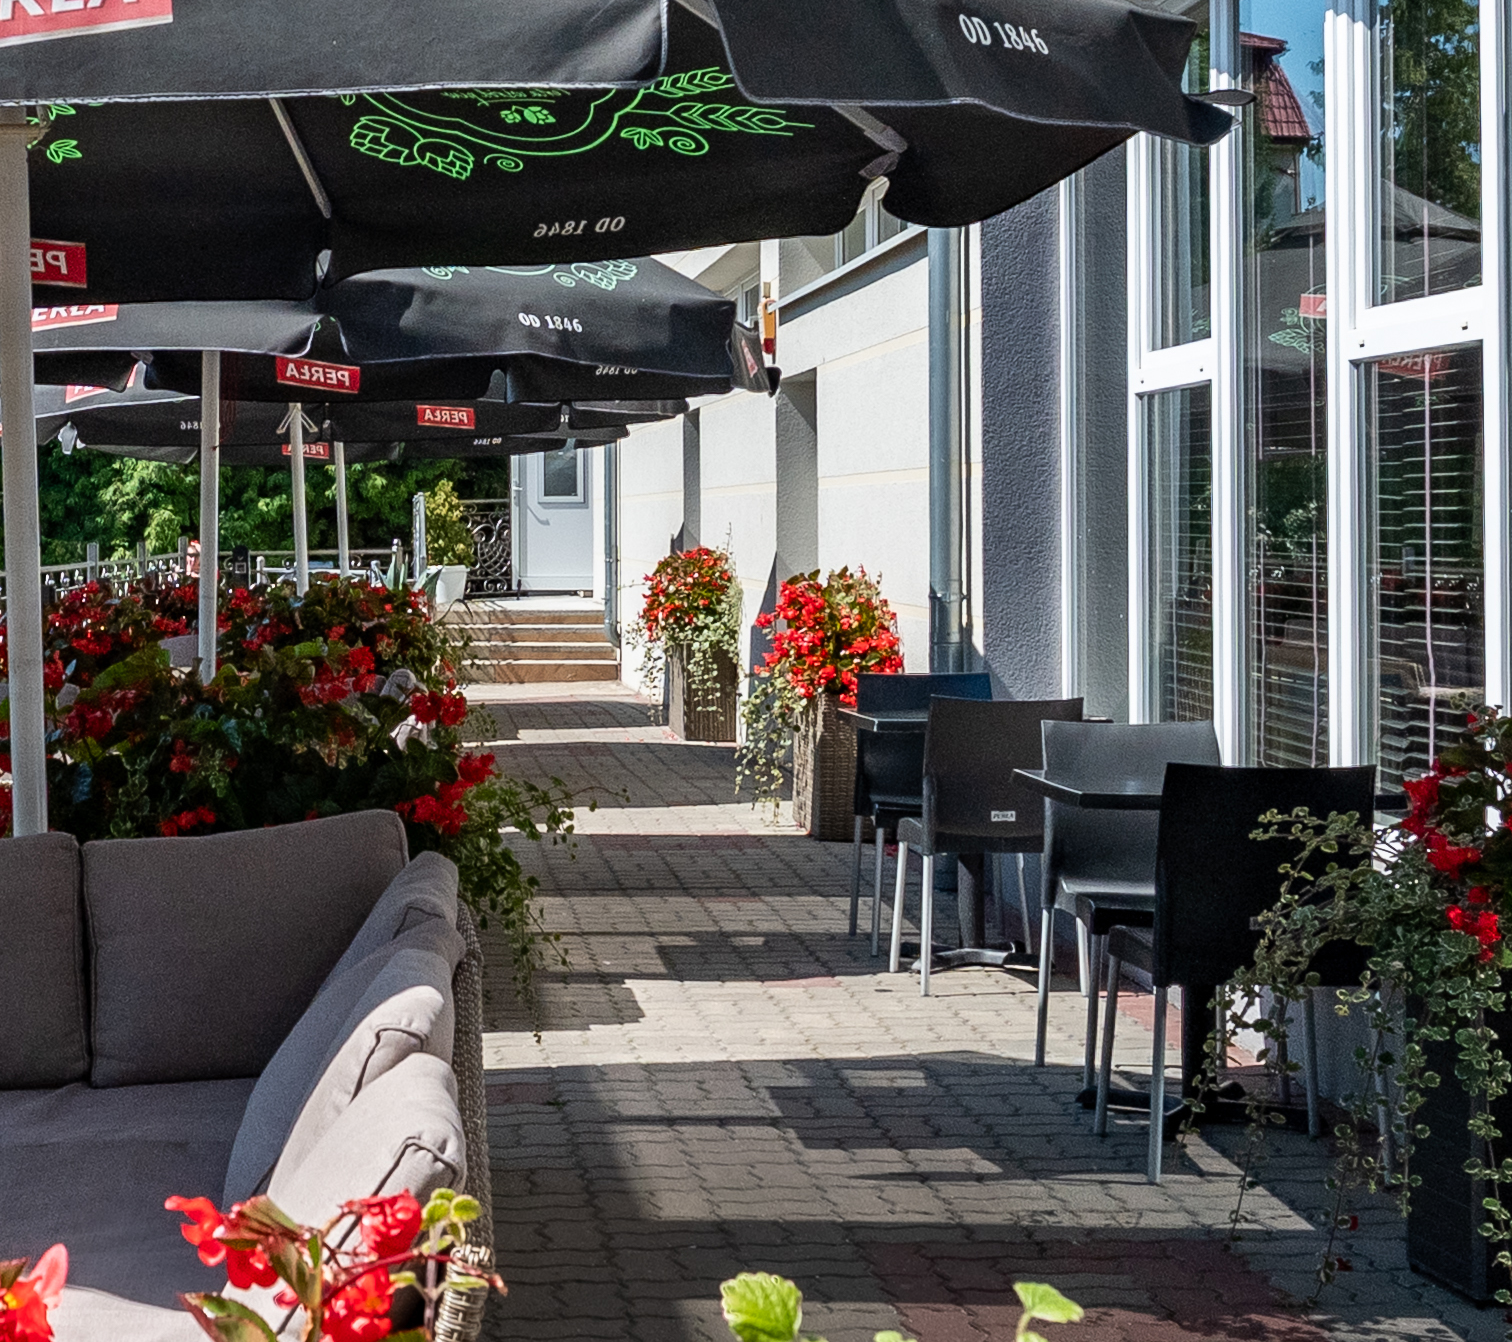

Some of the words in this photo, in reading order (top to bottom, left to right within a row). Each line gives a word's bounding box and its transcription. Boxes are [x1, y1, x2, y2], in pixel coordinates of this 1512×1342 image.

[959, 14, 991, 45] OD
[993, 22, 1049, 54] 1846
[518, 312, 541, 327] OD
[544, 315, 582, 332] 1846
